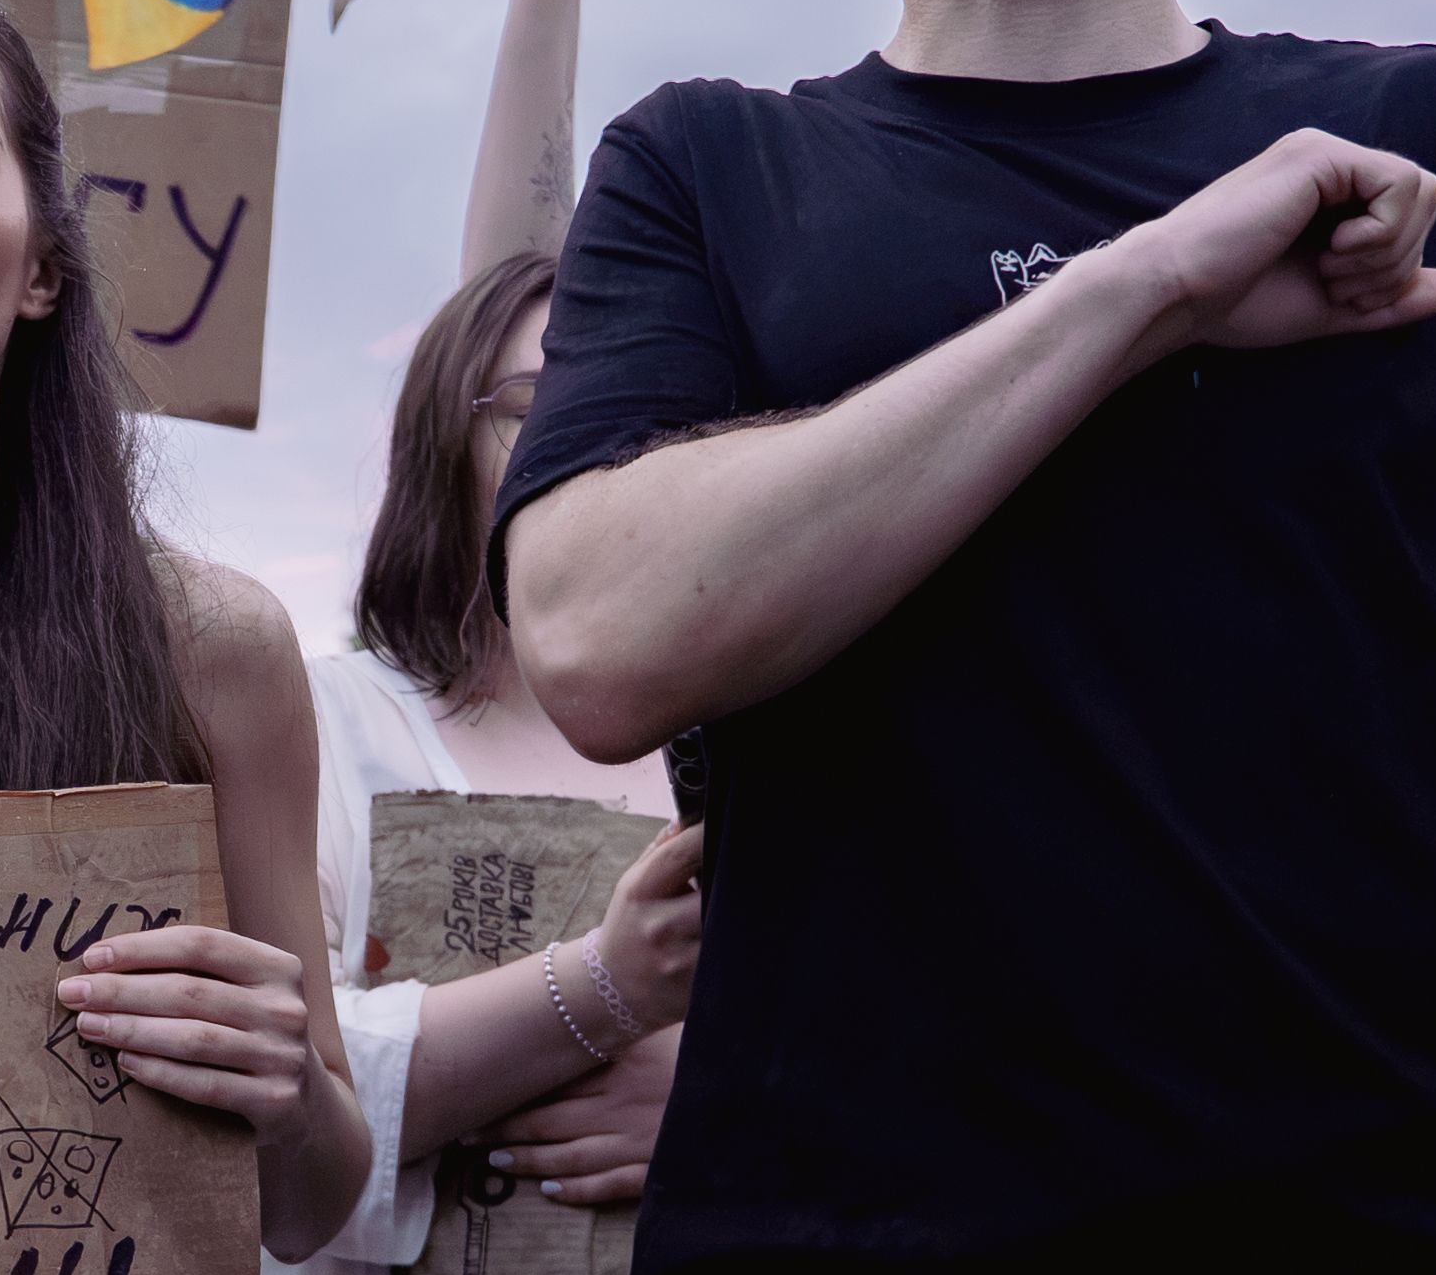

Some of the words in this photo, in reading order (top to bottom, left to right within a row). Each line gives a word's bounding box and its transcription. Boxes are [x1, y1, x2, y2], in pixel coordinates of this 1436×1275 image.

[447, 854, 479, 914] РОКІВ
[477, 852, 510, 967] ДОСТАВКА
[442, 908, 477, 954] 25
